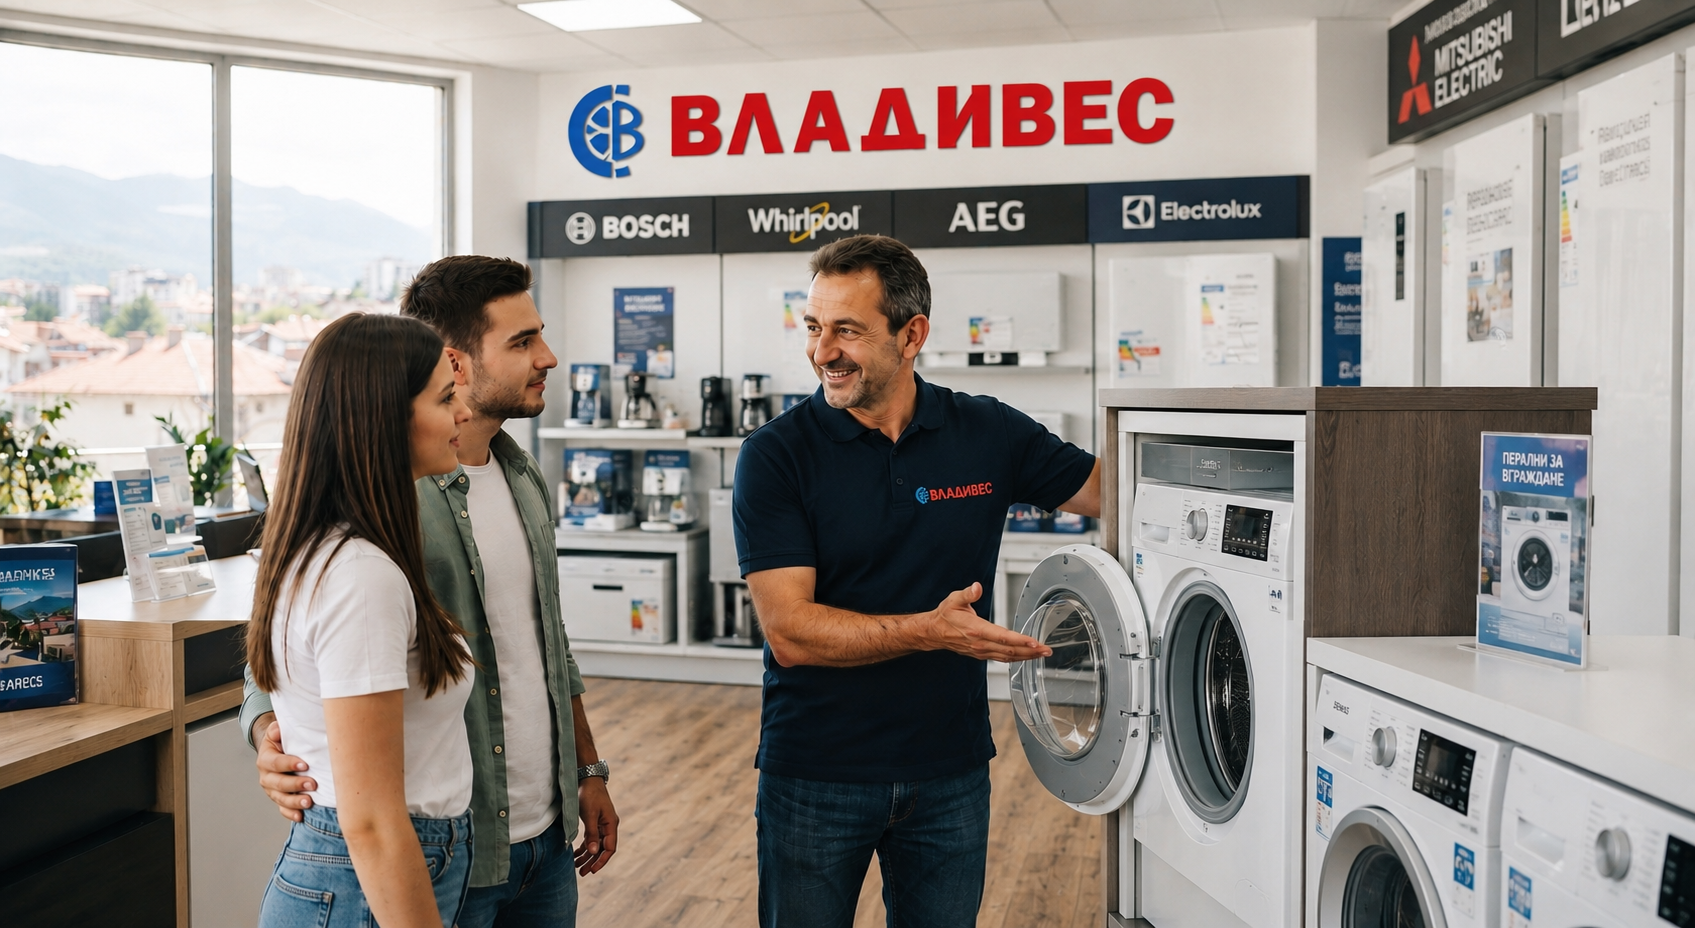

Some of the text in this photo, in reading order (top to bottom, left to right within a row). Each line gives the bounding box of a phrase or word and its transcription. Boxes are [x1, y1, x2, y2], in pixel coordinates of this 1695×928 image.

[1434, 10, 1512, 77] MITSUBISHI
[1434, 49, 1503, 109] ELECTRIC
[672, 77, 1174, 157] ВЛАДИВЕС
[748, 204, 860, 240] Whirlpool
[948, 200, 1025, 232] AEG
[1161, 199, 1262, 221] Electrolux
[602, 213, 690, 240] BOSCH
[1502, 451, 1564, 468] ПЕРАЛНИ ЗА
[929, 482, 993, 501] ВЛАДИВЕС
[1502, 468, 1564, 487] ВГРАЖДАНЕ
